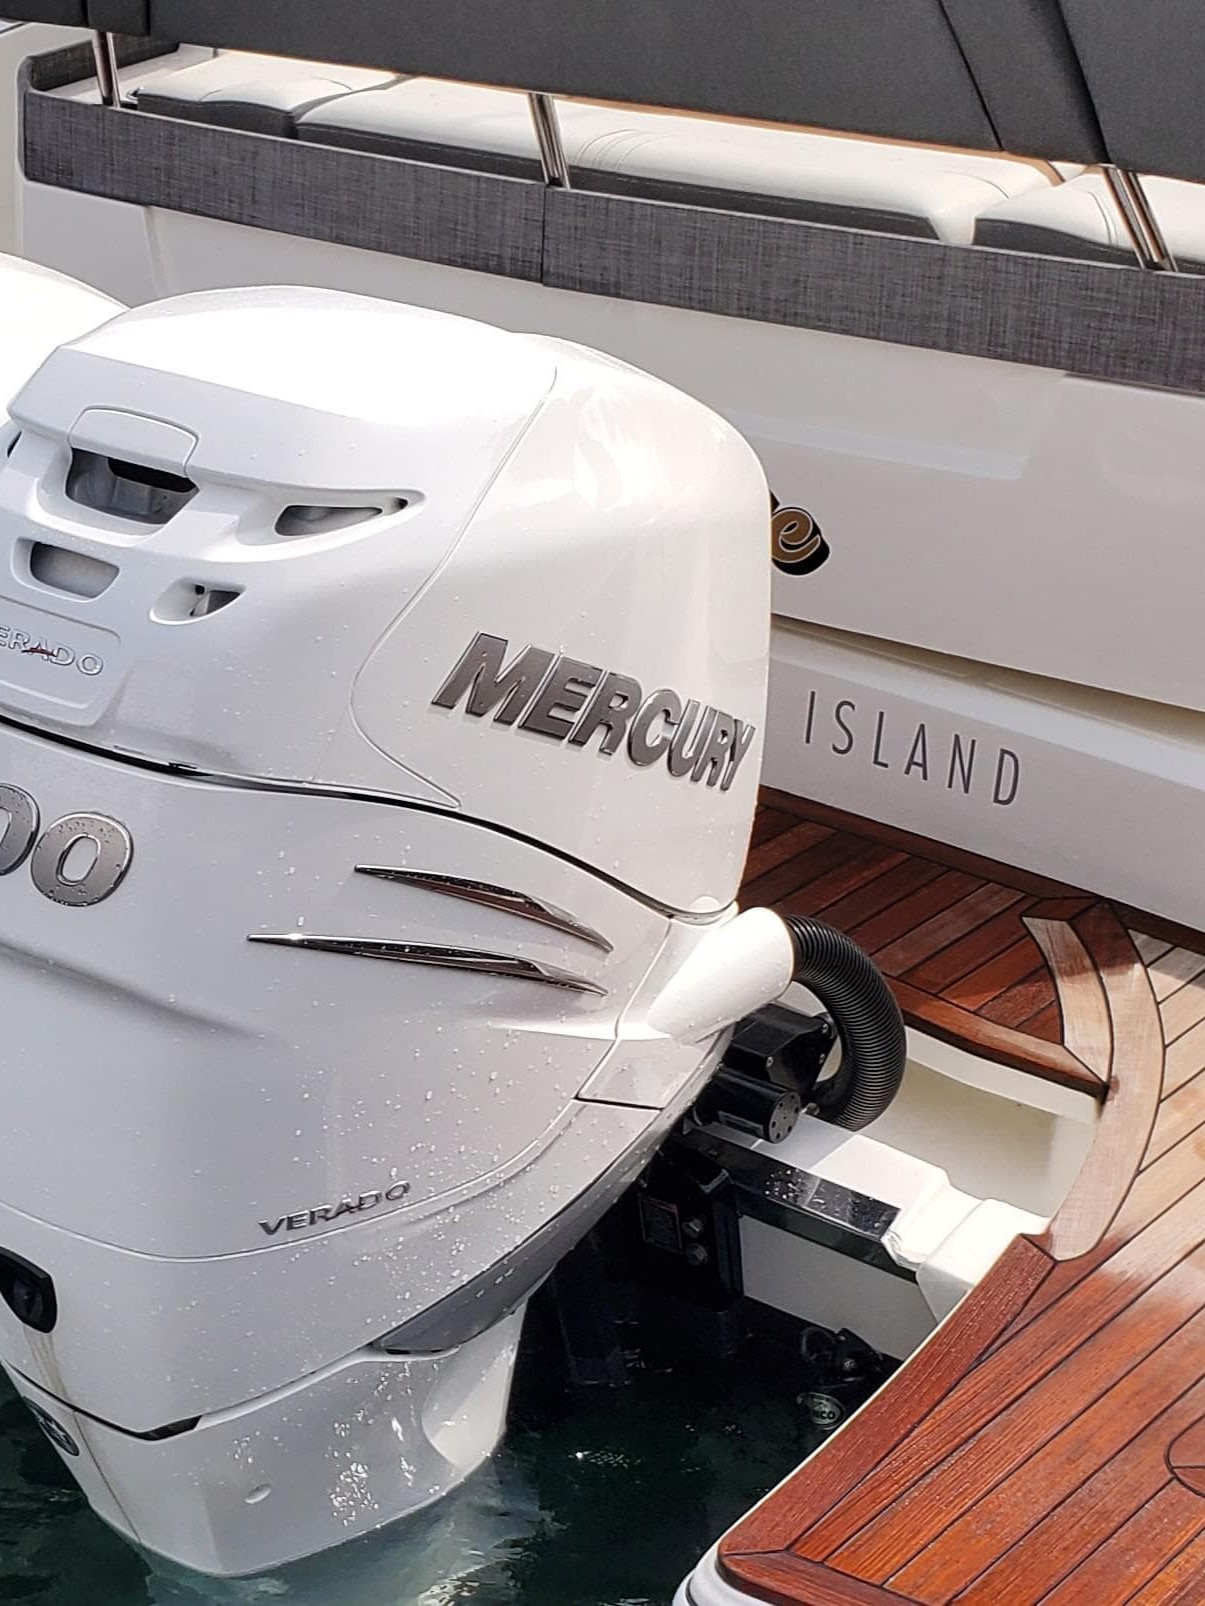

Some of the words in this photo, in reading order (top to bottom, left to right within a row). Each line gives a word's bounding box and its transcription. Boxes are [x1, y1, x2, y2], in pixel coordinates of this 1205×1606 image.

[431, 630, 756, 791] MERCURY
[805, 690, 1020, 806] ISLAND
[258, 1180, 411, 1235] VERADO
